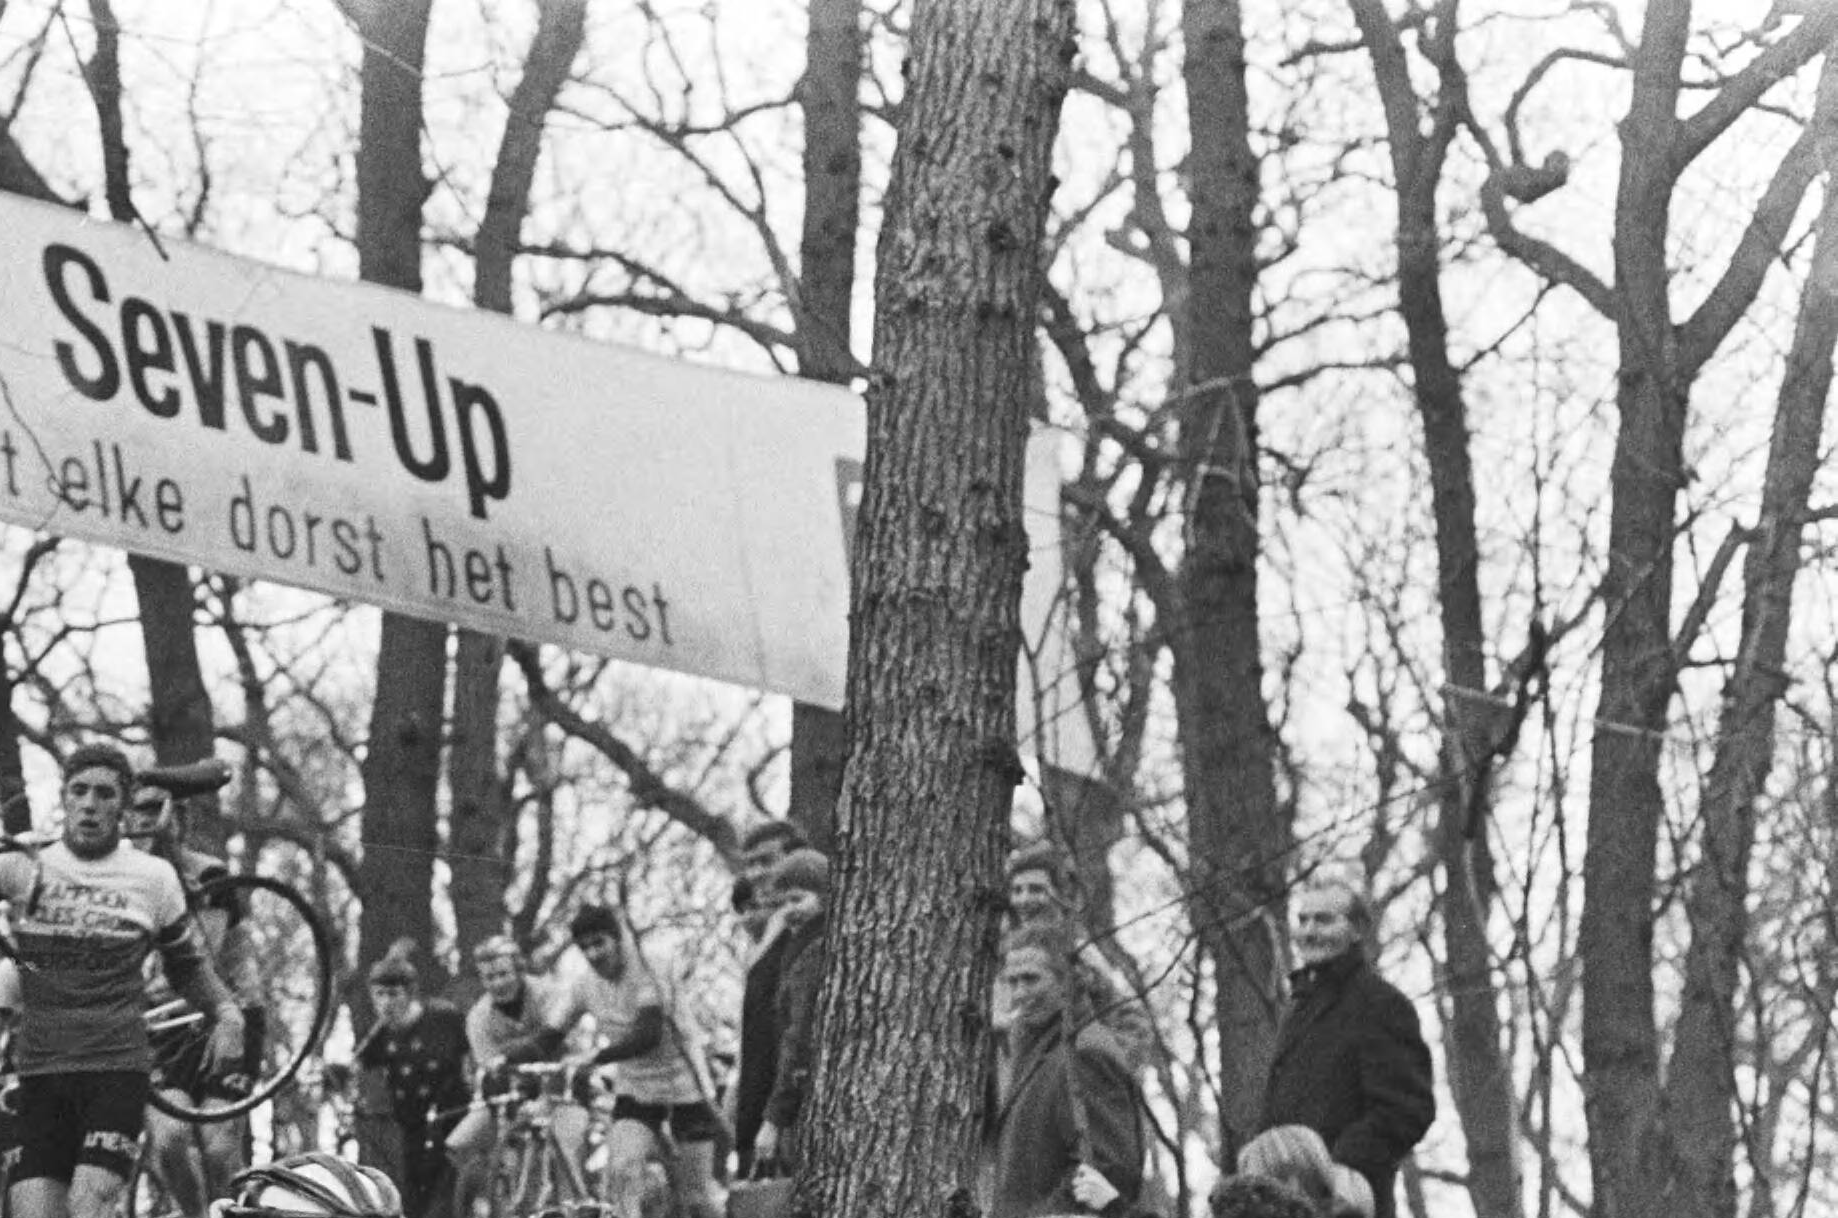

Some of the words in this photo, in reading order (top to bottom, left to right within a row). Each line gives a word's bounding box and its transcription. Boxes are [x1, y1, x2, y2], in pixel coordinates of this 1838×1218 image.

[42, 241, 510, 519] Seven-Up
[61, 440, 185, 535] elke
[230, 474, 387, 581] dorst
[422, 518, 517, 612] het
[545, 546, 675, 647] best
